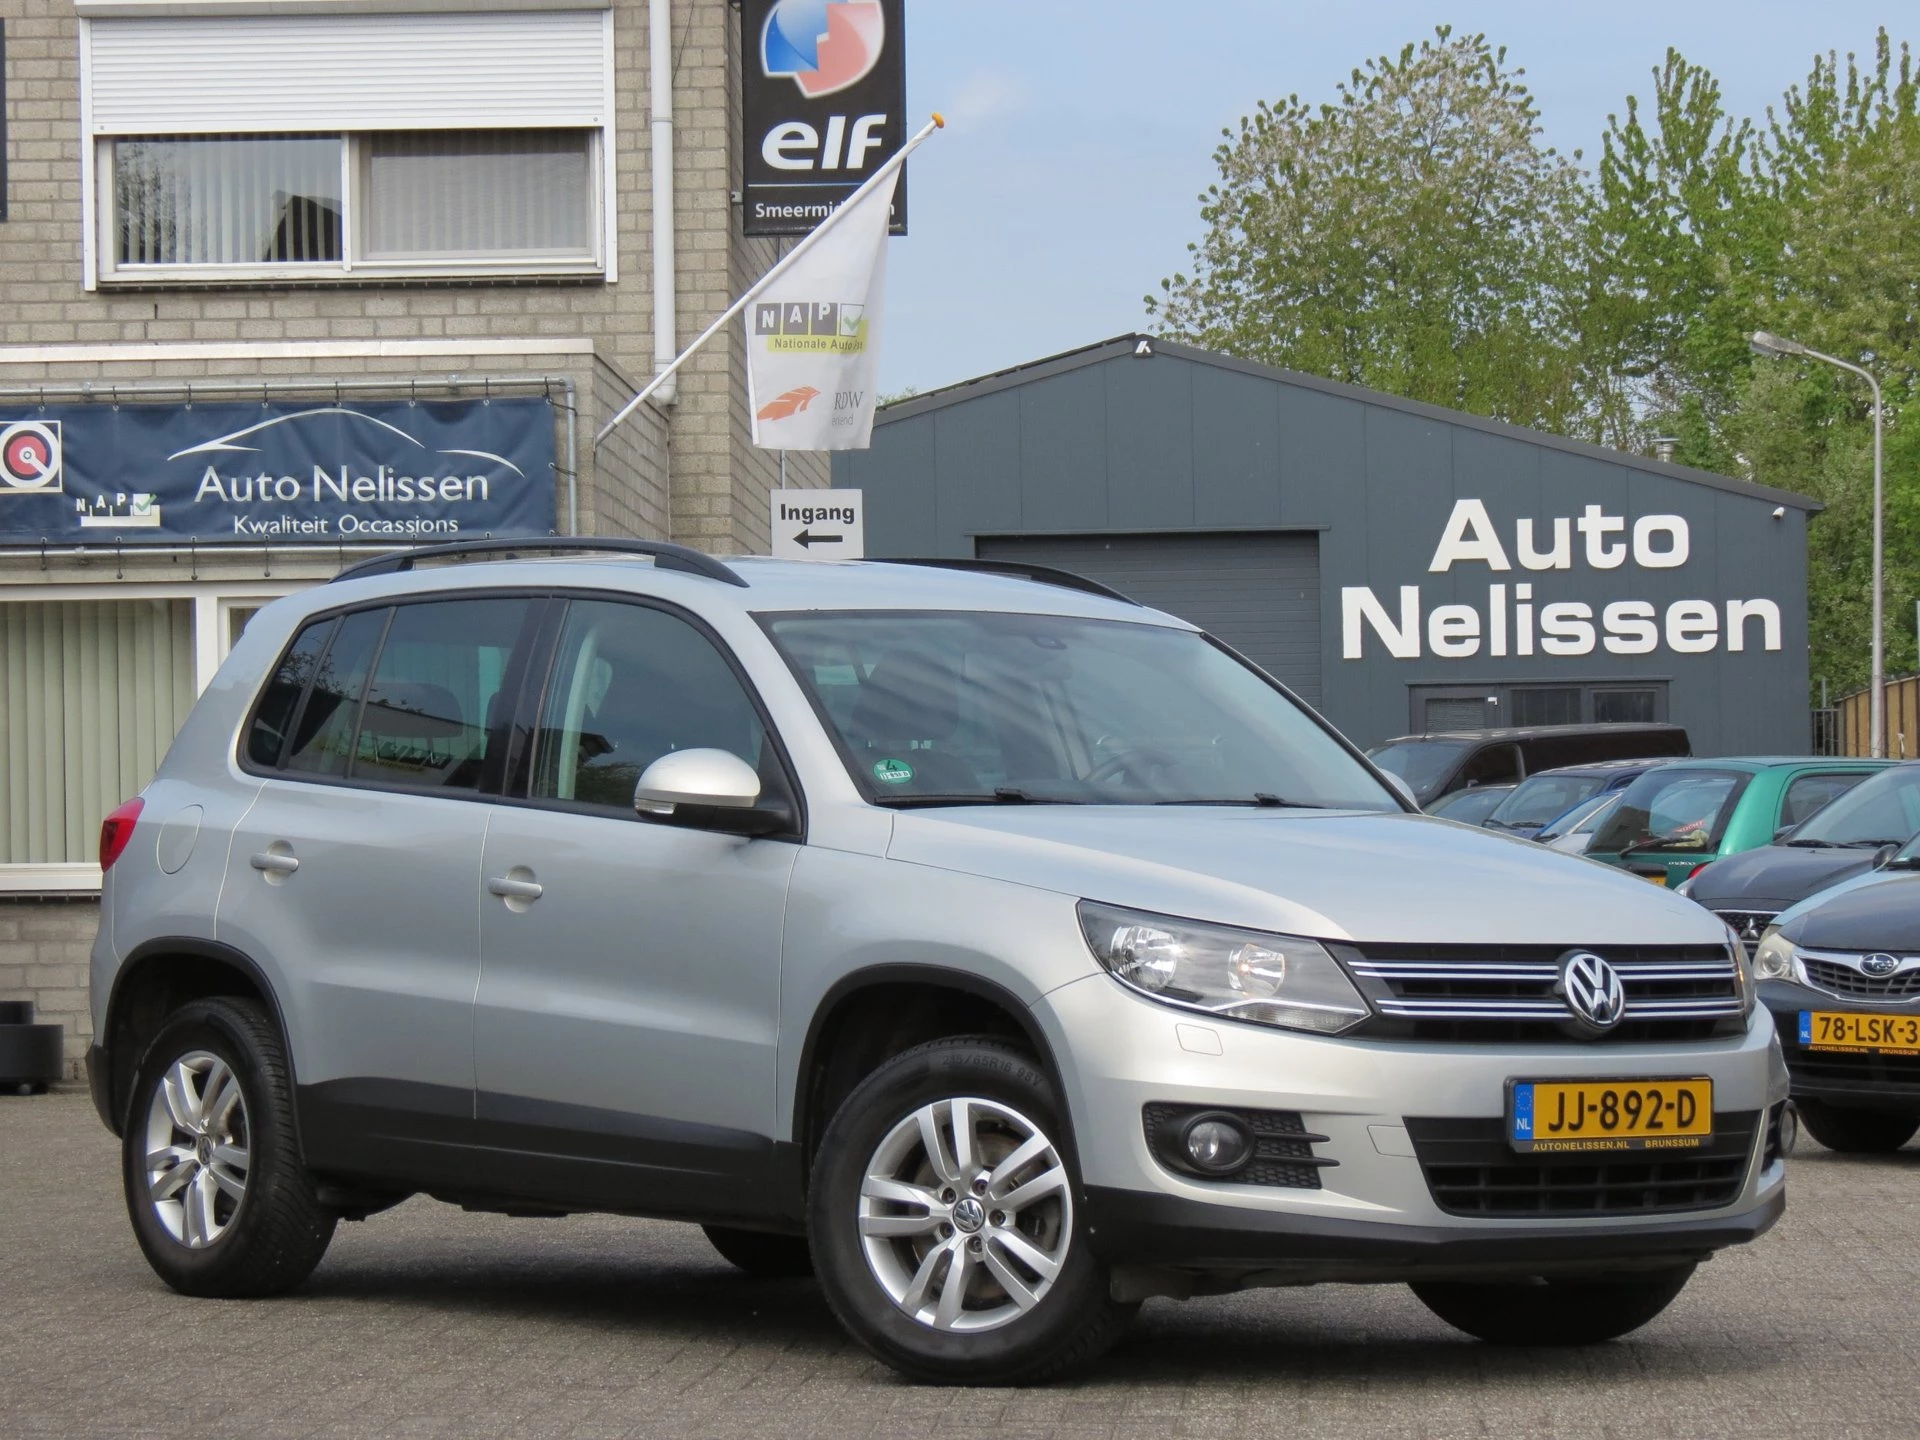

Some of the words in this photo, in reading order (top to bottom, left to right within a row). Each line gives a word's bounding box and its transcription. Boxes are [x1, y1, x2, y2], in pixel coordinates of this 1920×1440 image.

[761, 113, 887, 170] elf
[775, 338, 827, 349] Nationale
[834, 391, 864, 410] RDW
[194, 465, 301, 502] Auto
[313, 465, 489, 502] Nelissen
[233, 515, 329, 535] Kwaliteit
[338, 513, 459, 534] Occassions
[780, 503, 855, 525] Ingang
[1427, 498, 1690, 573] Auto
[1341, 582, 1782, 660] Nelissen
[1818, 1016, 1918, 1044] 78-LSK-3
[1547, 1088, 1697, 1132] JJ-892-D
[1516, 1117, 1531, 1130] NL
[1532, 1140, 1631, 1151] AUTONELISSEN.NL
[1644, 1138, 1700, 1149] BRUNSSUM
